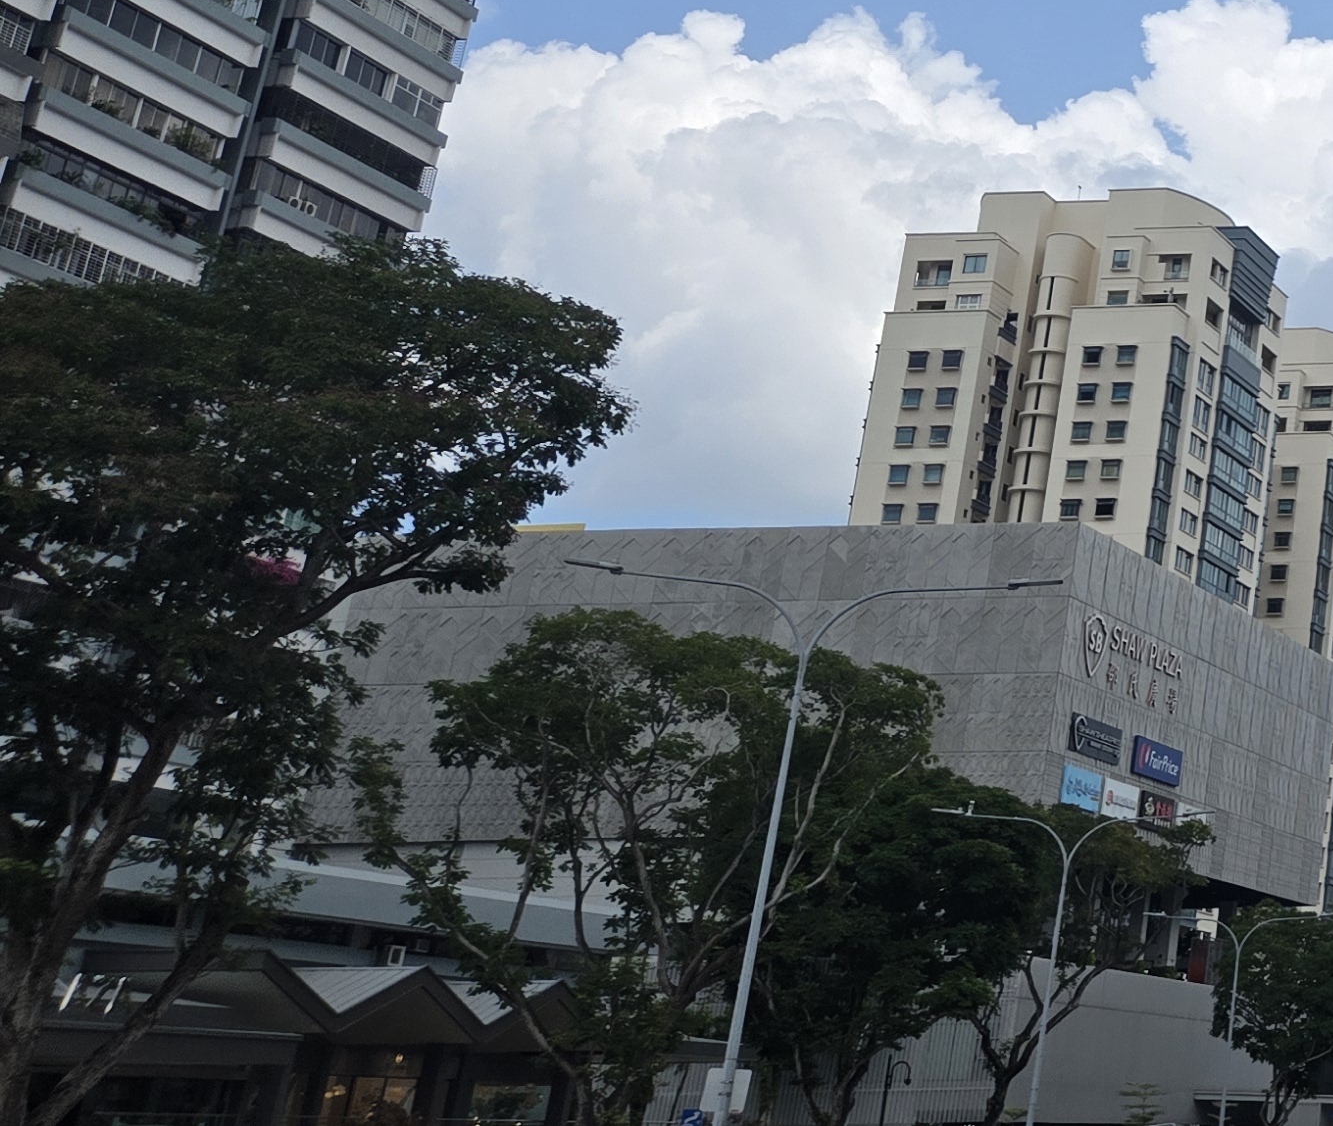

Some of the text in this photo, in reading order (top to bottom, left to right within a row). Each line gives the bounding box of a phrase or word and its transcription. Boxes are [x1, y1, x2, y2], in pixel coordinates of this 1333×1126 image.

[1088, 629, 1103, 653] SB
[1111, 625, 1183, 680] SHAW PLAZA
[1149, 750, 1179, 776] FairPrice
